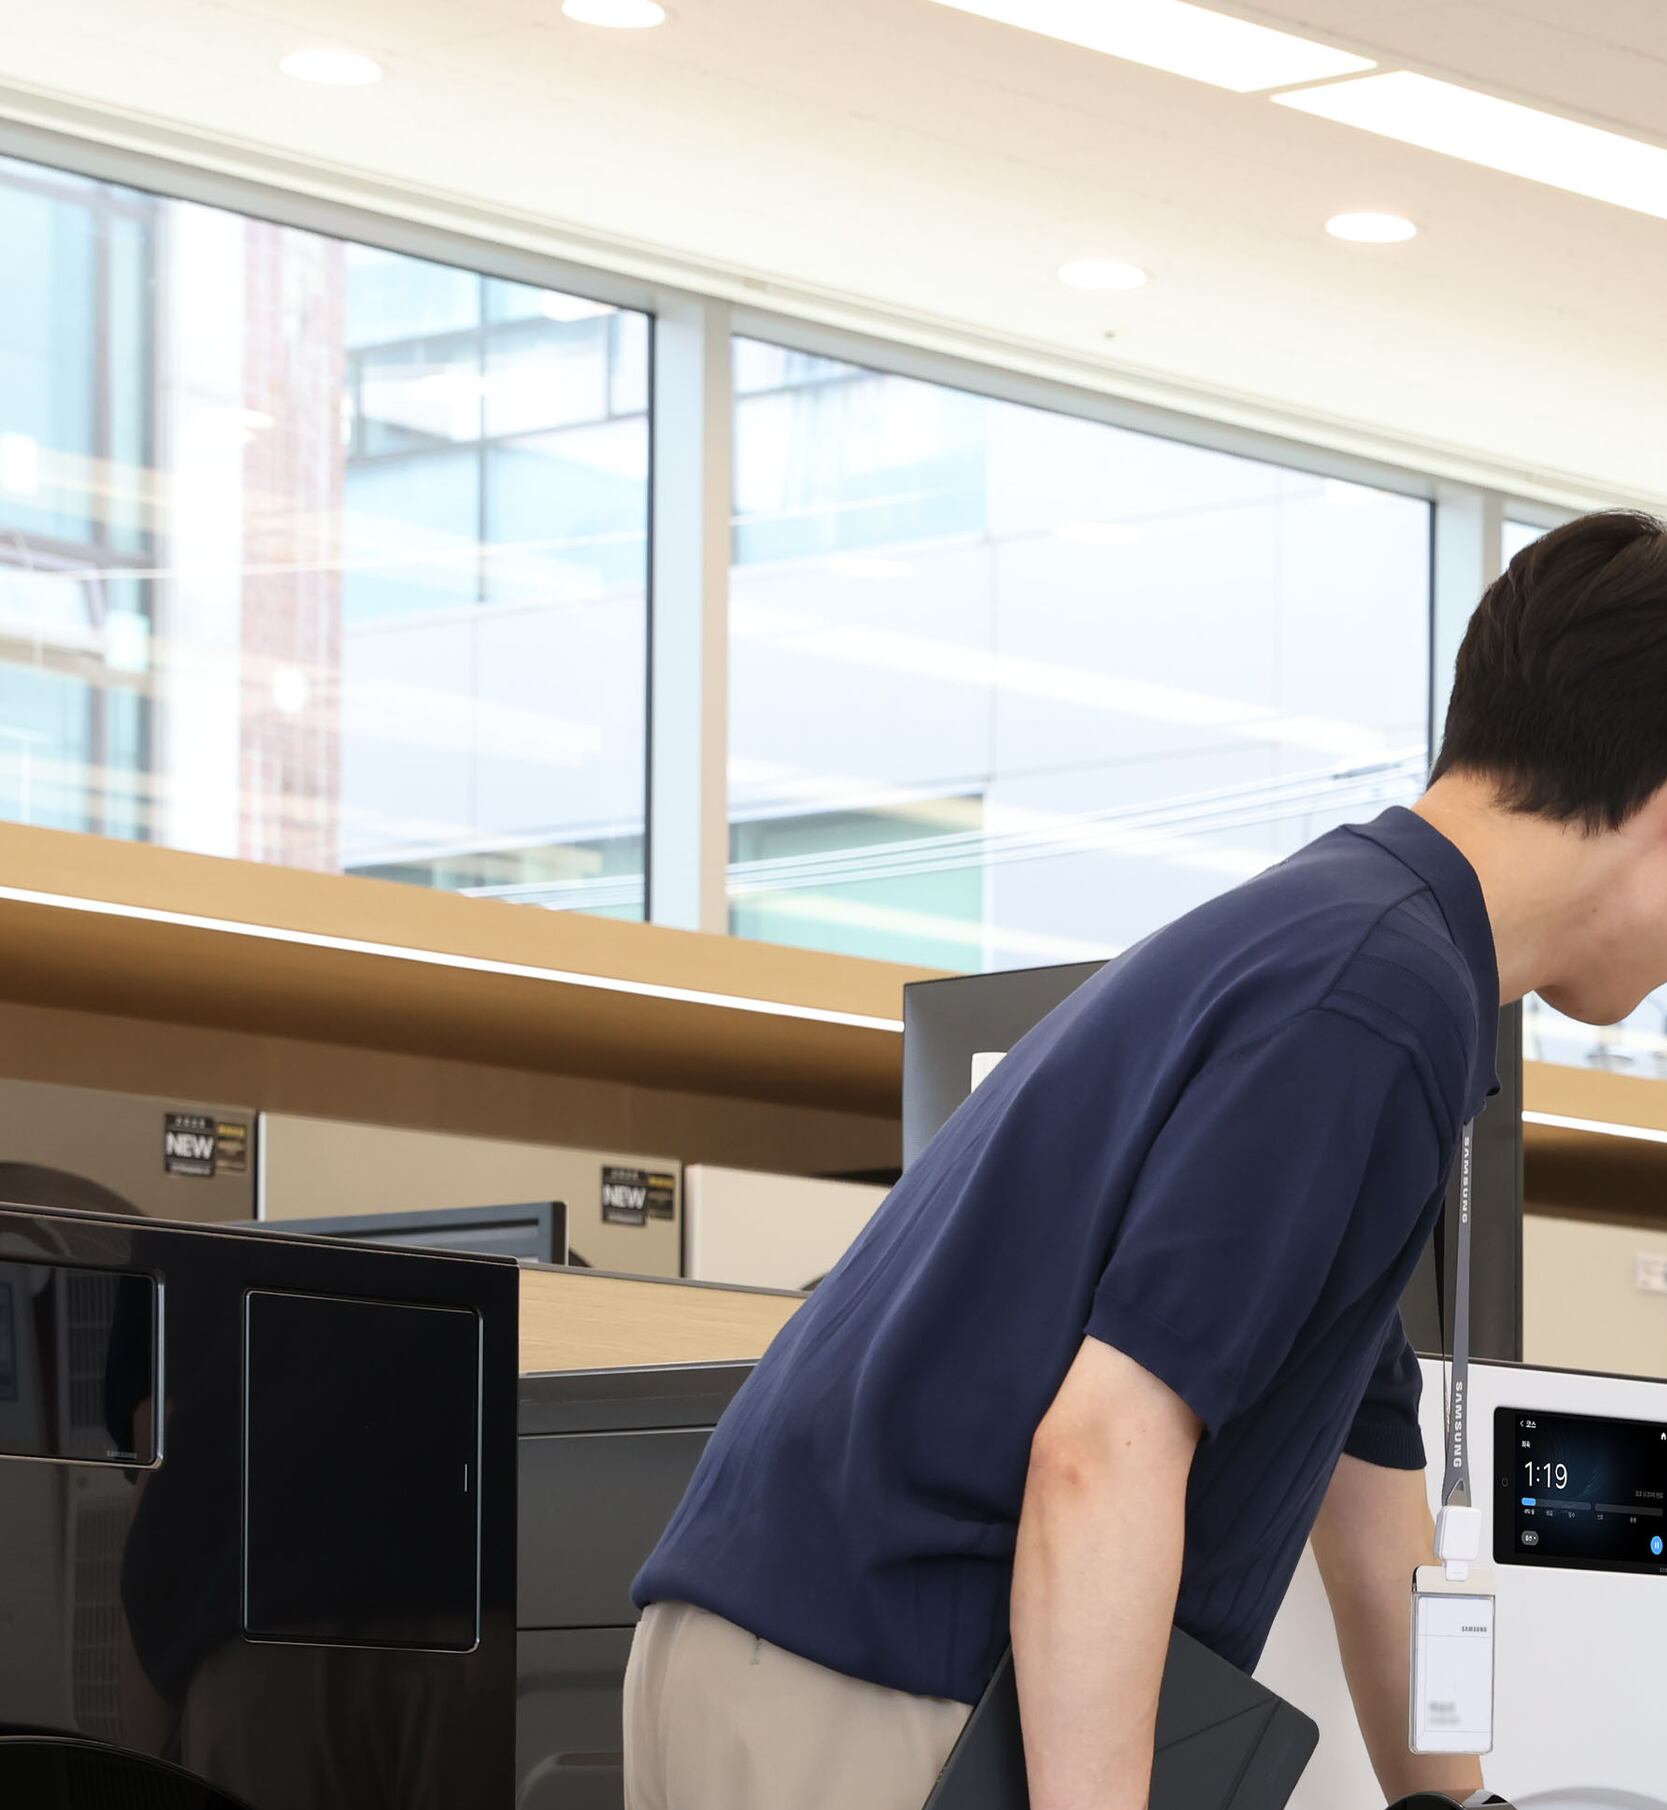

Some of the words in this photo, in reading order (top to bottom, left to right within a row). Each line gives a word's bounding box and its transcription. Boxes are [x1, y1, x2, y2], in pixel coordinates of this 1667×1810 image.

[166, 1131, 214, 1159] NEW
[1462, 1136, 1470, 1224] SAMSUNG
[603, 1184, 646, 1209] NEW
[1453, 1381, 1463, 1468] SAMSUNG
[1524, 1461, 1568, 1490] 1:19
